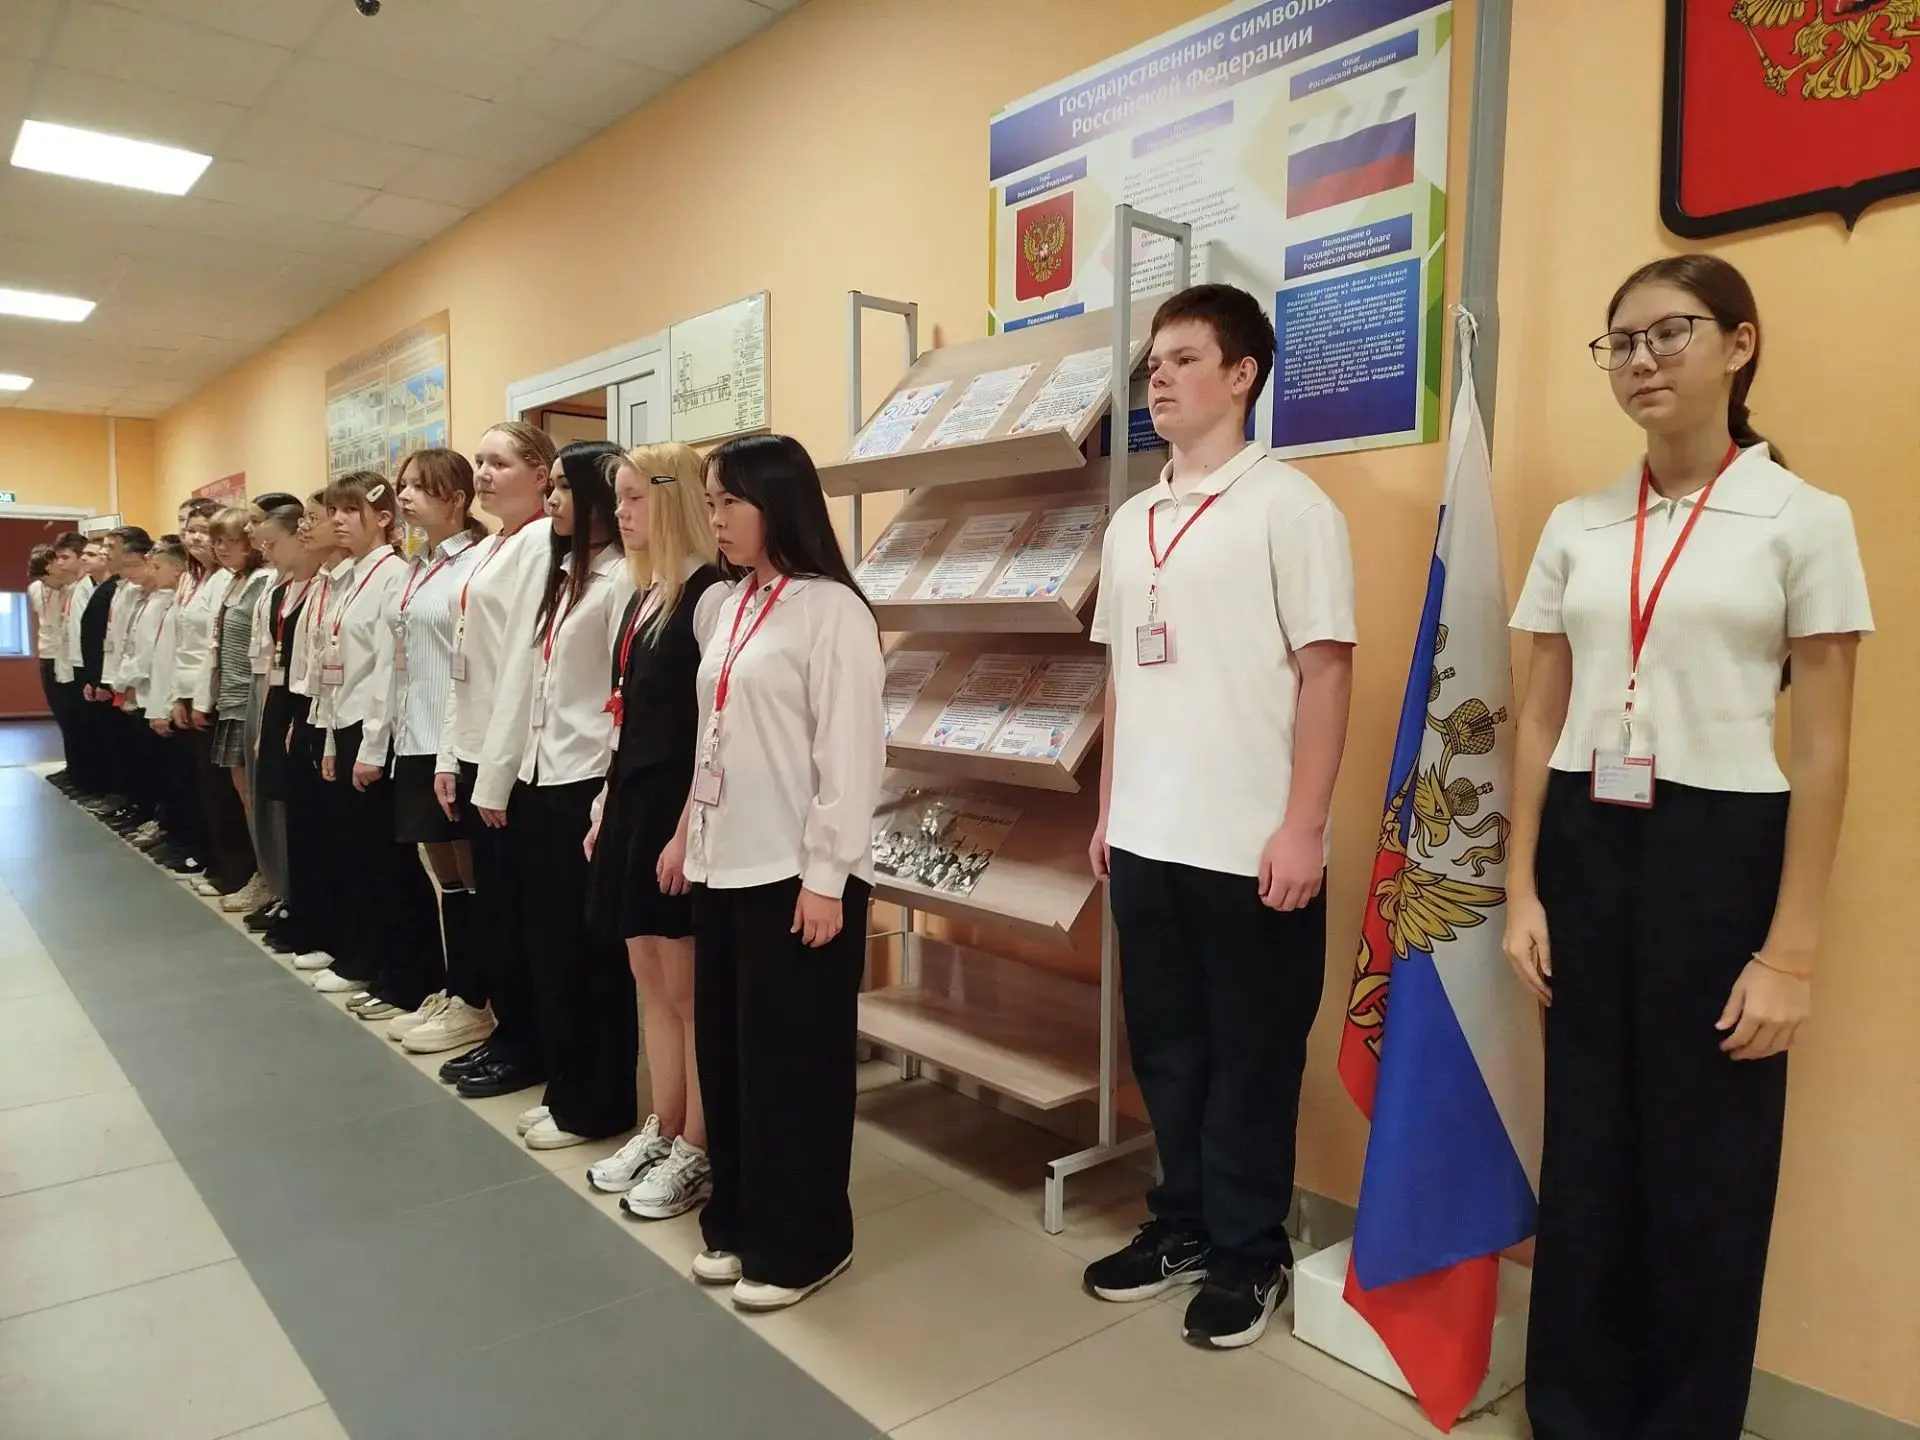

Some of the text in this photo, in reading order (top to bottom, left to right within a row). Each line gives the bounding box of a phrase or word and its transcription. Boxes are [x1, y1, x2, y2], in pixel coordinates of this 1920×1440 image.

[1059, 31, 1225, 117] Государственные
[1309, 51, 1397, 90] Российской Федерации
[1342, 55, 1361, 68] Флаг
[1072, 73, 1181, 138] Российской
[1186, 25, 1313, 89] Федерации
[1303, 233, 1391, 262] Государственном флаге
[1322, 229, 1371, 248] Положение о
[1303, 243, 1391, 271] Российской Федерации
[1365, 328, 1405, 342] российского
